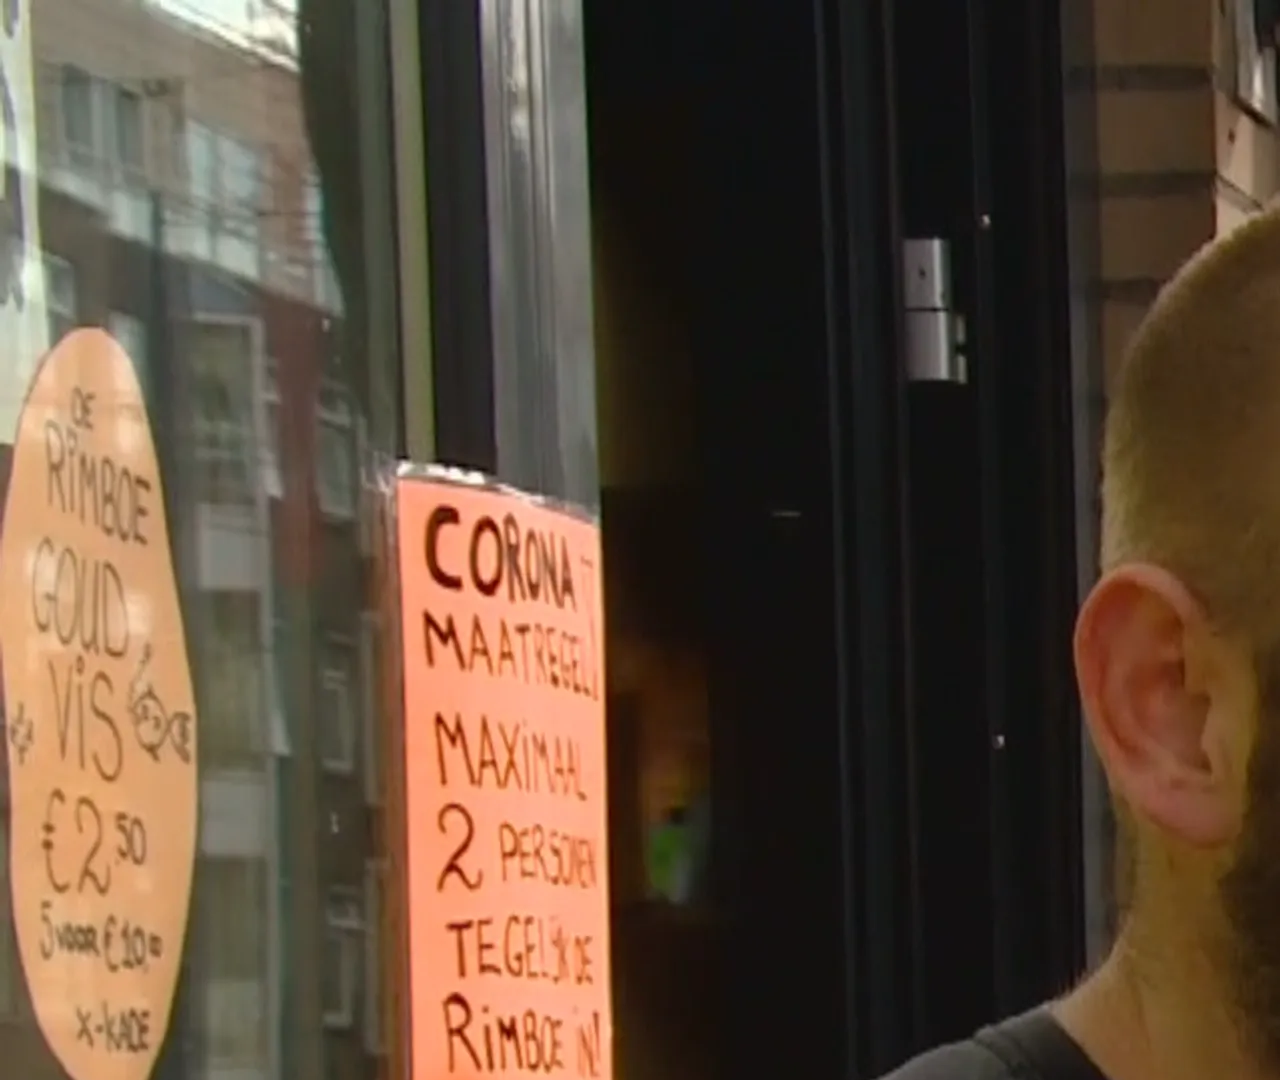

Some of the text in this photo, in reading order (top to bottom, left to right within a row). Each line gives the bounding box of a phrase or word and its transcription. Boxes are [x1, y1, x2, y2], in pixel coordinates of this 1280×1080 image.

[73, 386, 95, 428] DE
[33, 537, 130, 658] GOUD
[425, 505, 577, 612] CORONA
[436, 803, 483, 893] 2
